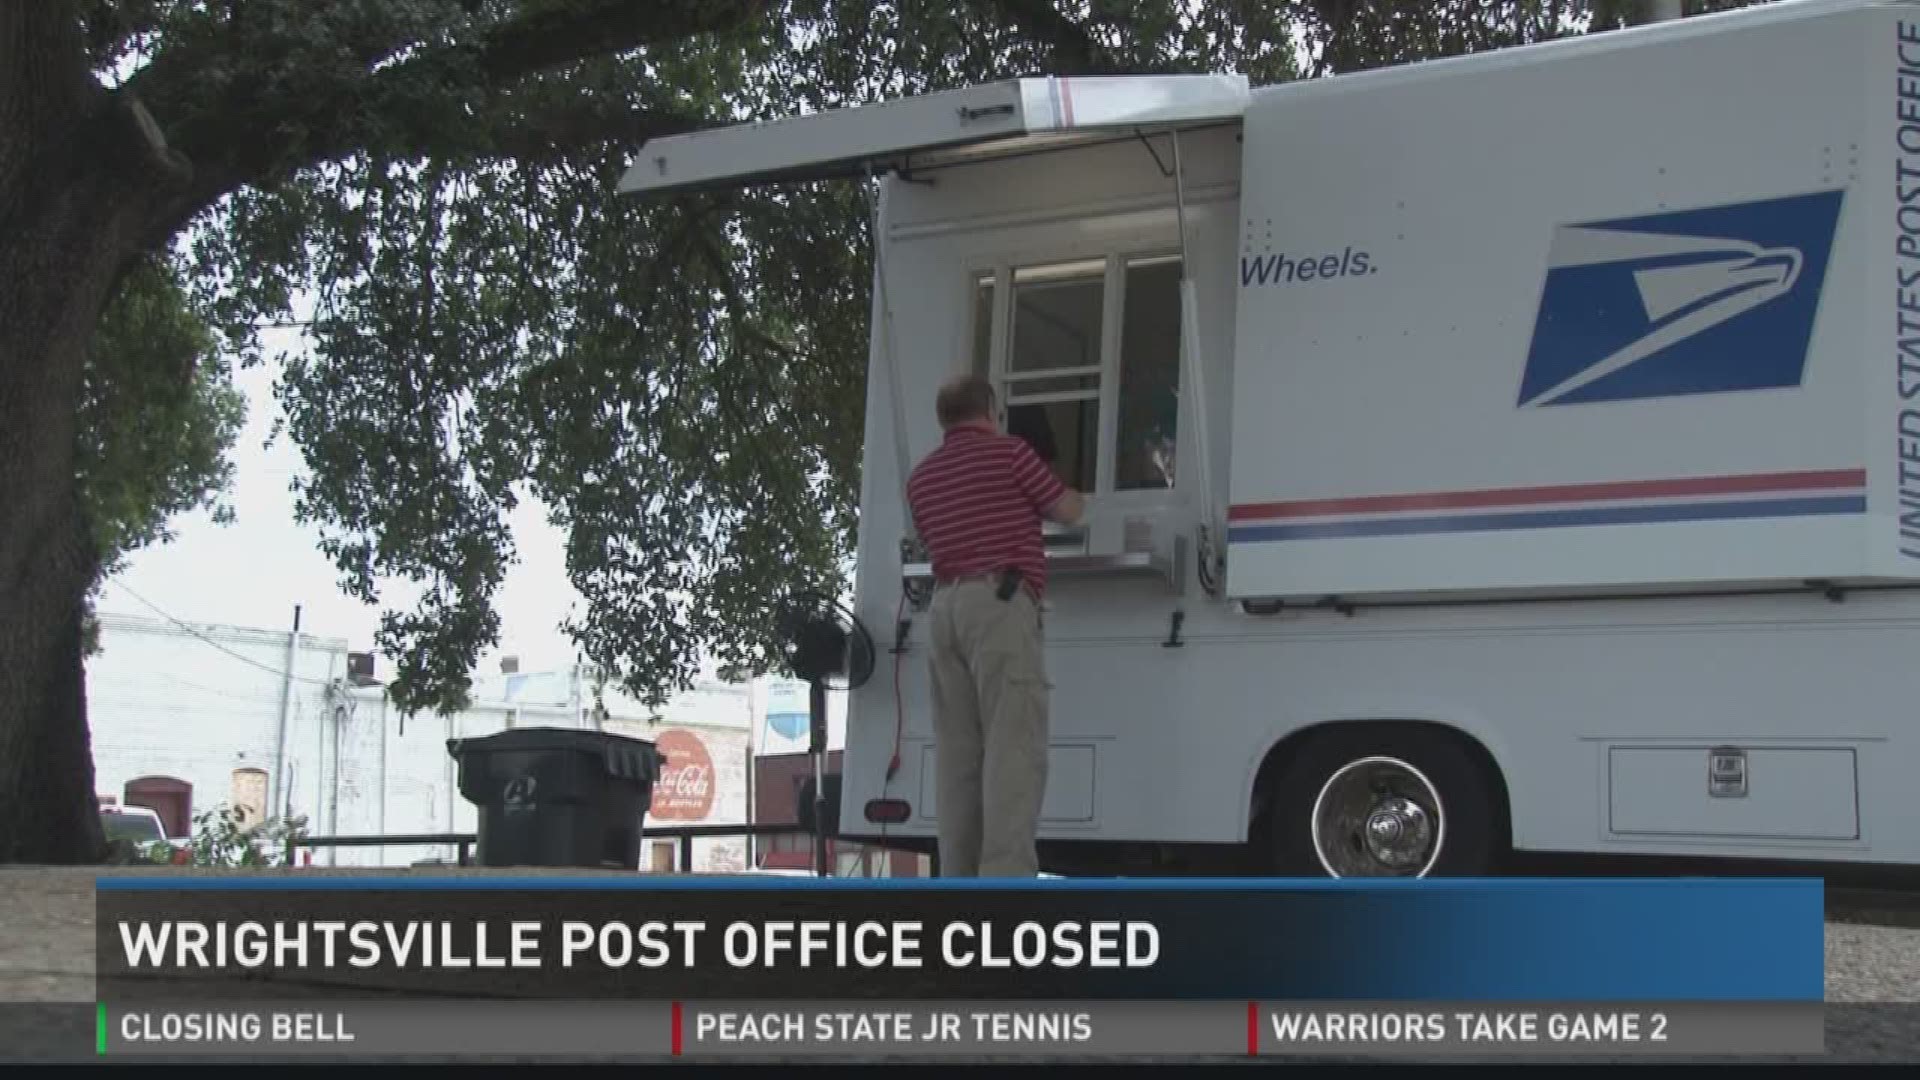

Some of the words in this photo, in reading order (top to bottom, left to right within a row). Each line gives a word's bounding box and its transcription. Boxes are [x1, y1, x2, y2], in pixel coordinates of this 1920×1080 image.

[1896, 19, 1920, 154] OFFICE
[1240, 246, 1379, 287] Wheels.
[1896, 157, 1920, 259] POST
[1897, 267, 1920, 401] STATES
[1898, 407, 1920, 559] UNITED
